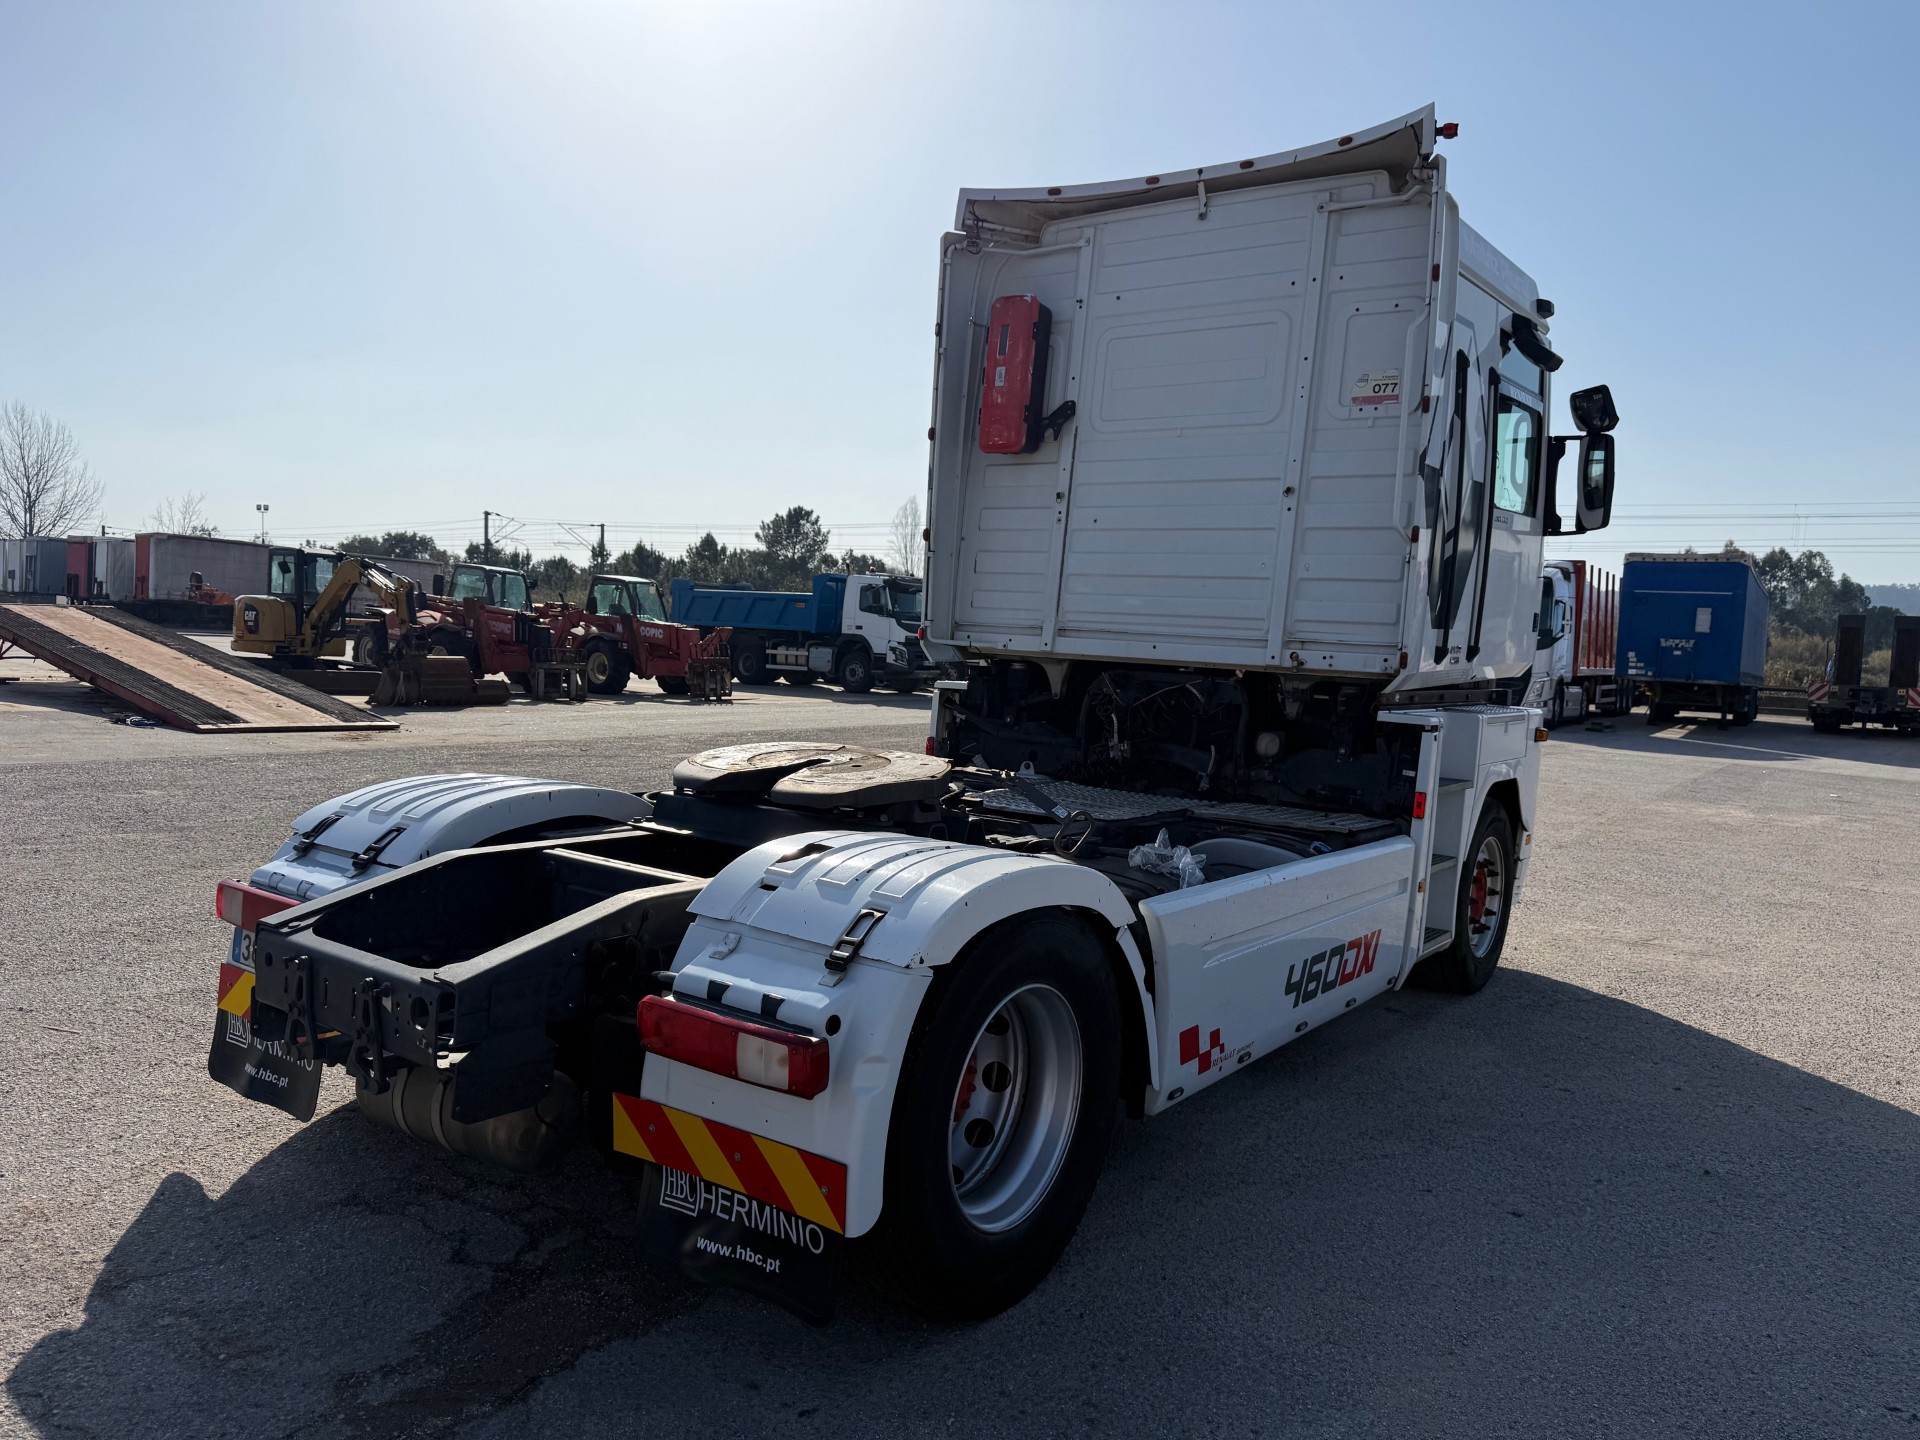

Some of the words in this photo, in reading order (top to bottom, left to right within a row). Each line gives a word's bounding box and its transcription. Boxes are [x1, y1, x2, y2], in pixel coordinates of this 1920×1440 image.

[1372, 382, 1399, 394] 077
[244, 610, 257, 621] CAT
[640, 626, 664, 639] COPIC
[1284, 928, 1382, 1009] 460DXI
[1211, 1048, 1236, 1068] RENAULT
[1236, 1041, 1255, 1055] SPORT
[244, 1061, 289, 1088] www.hbc.pt
[665, 1166, 696, 1203] HBC
[696, 1236, 781, 1273] www.hbc.pt
